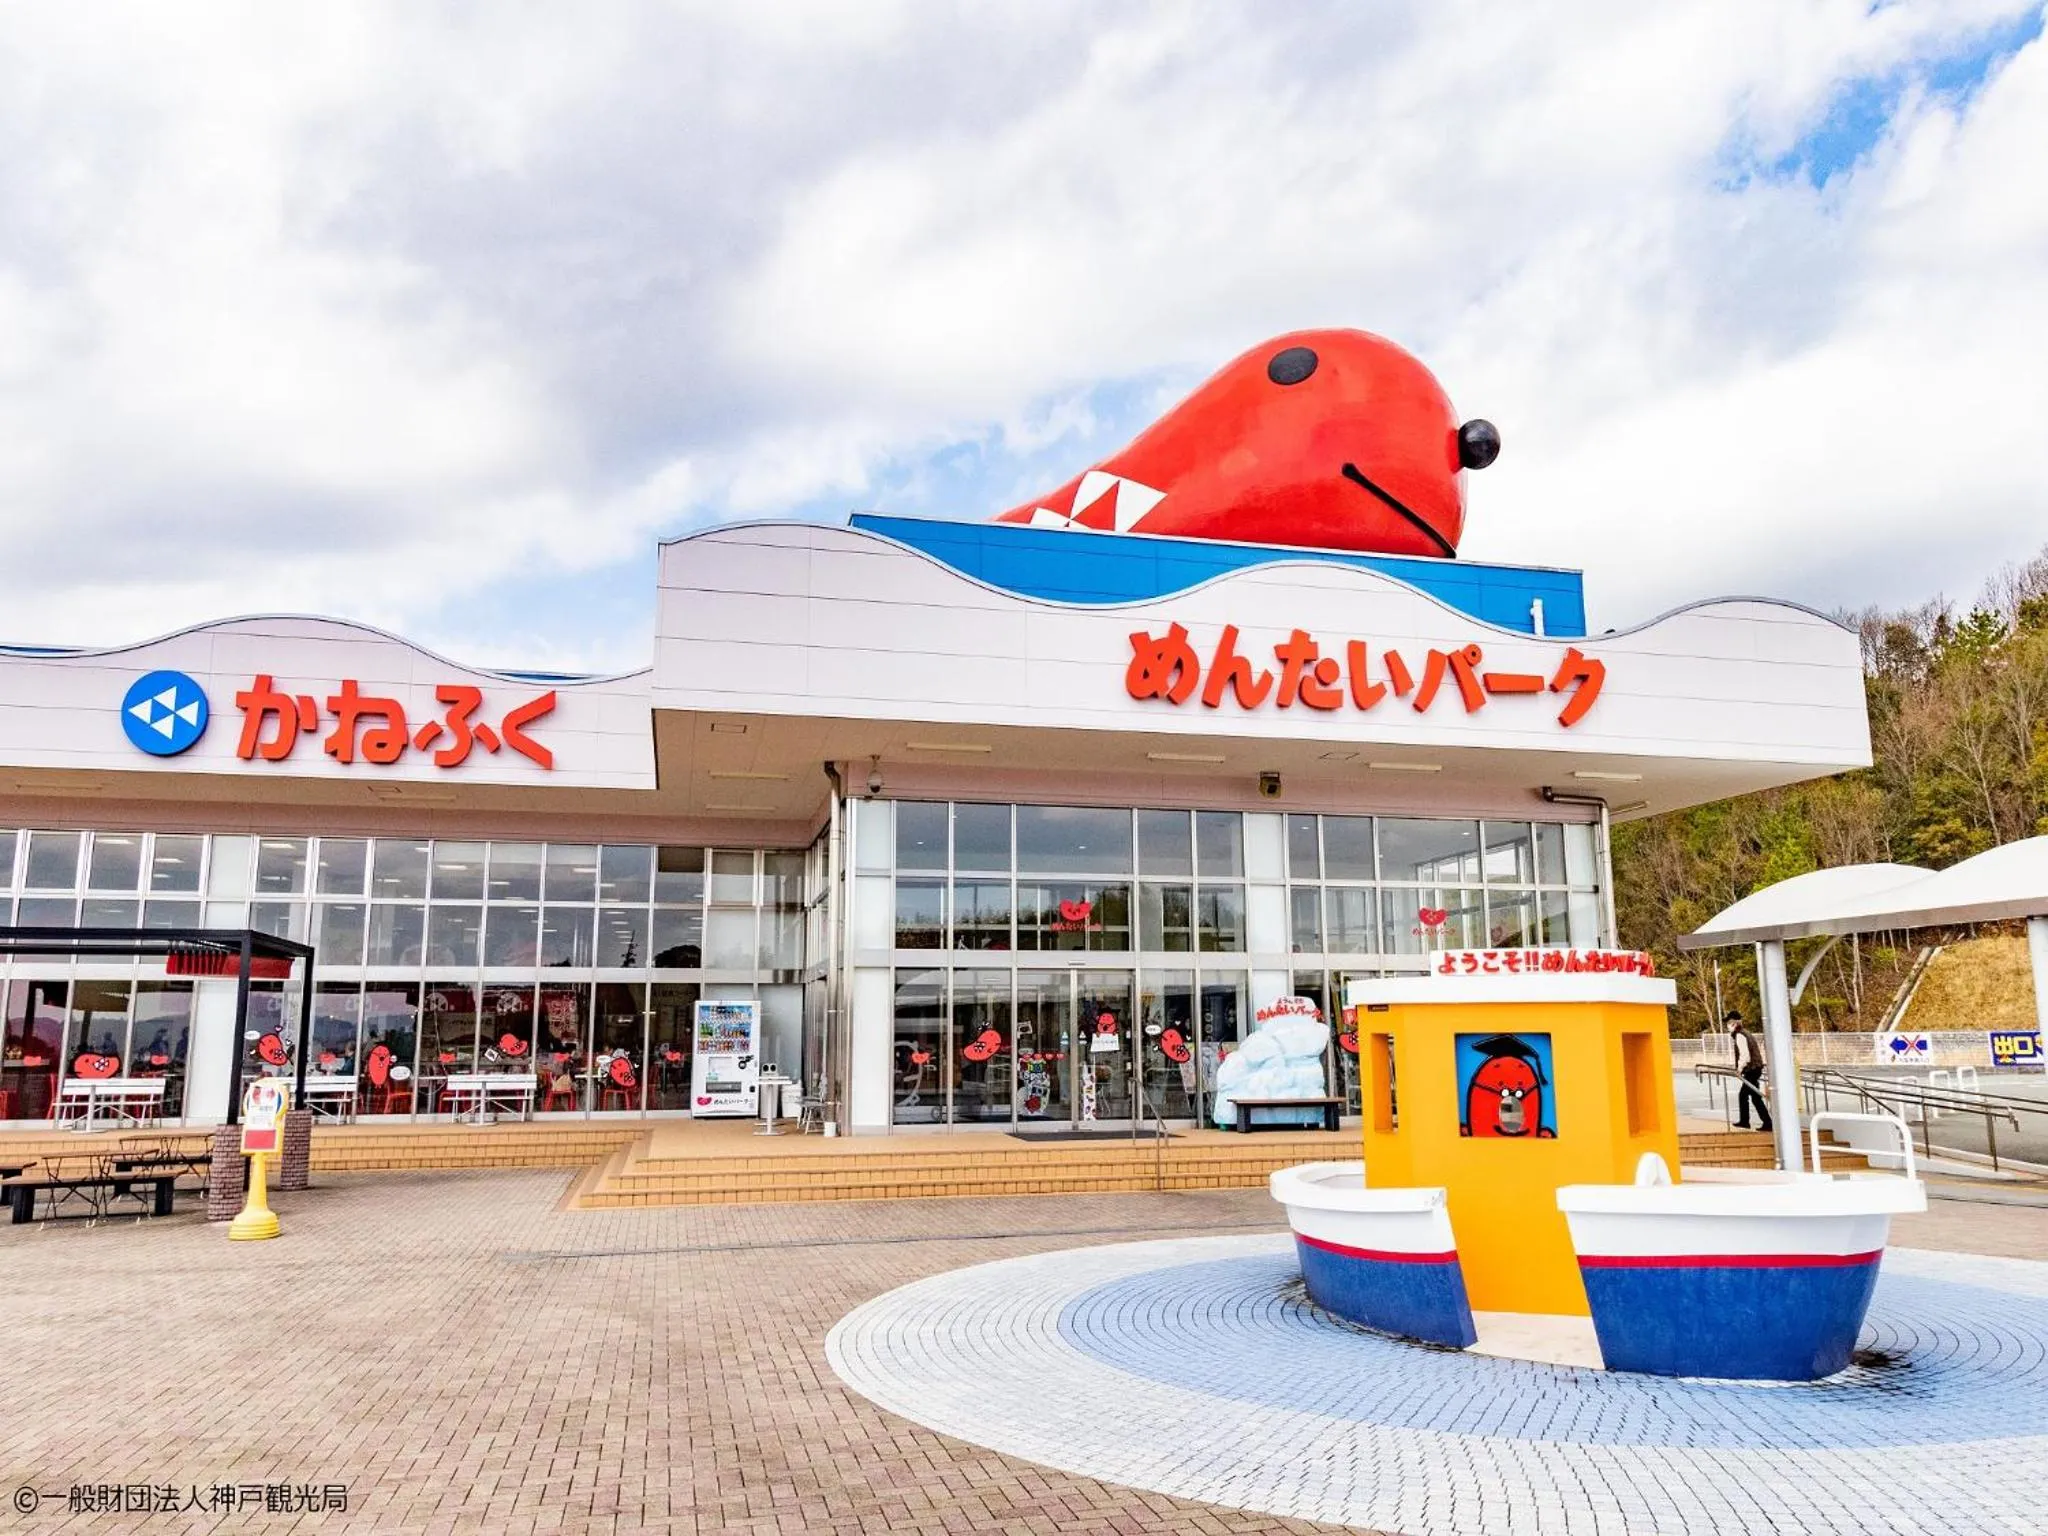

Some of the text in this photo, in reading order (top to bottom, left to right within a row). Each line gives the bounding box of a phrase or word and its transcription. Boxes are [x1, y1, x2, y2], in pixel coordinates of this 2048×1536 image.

[236, 674, 556, 771] かねふく
[1126, 622, 1606, 728] めんたいパーク
[1994, 1036, 2034, 1056] 出口
